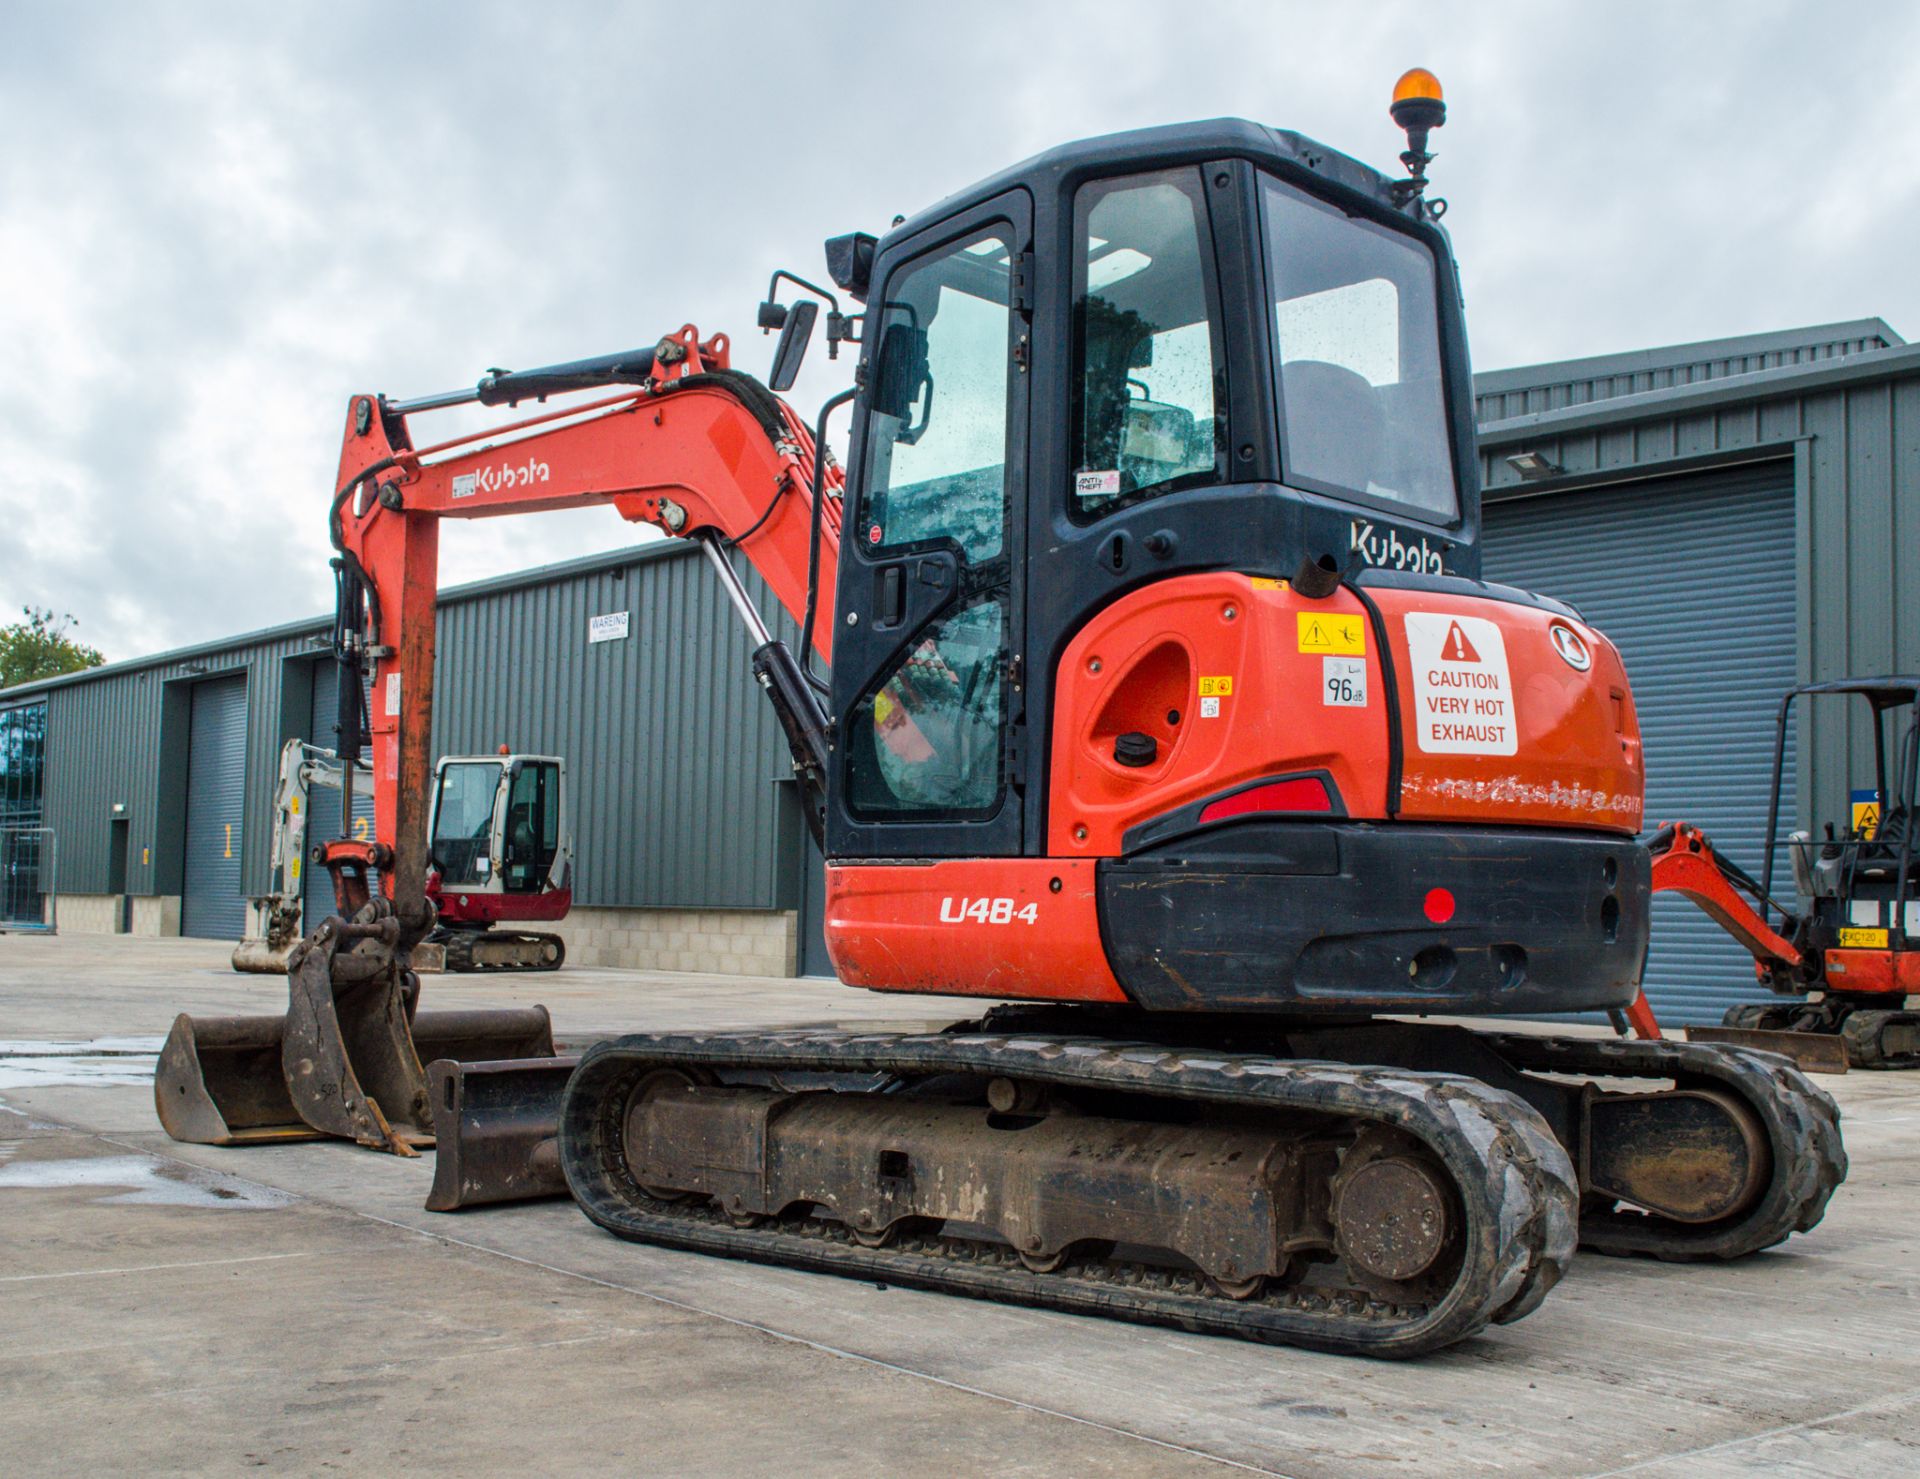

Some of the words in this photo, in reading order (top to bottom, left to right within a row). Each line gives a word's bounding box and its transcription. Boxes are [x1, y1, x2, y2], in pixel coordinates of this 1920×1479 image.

[476, 458, 549, 492] Kubota
[1351, 521, 1443, 576] Kubota
[592, 613, 627, 629] WAREING
[1328, 678, 1352, 702] 96
[1428, 670, 1499, 690] CAUTION
[1426, 696, 1469, 714] VERY
[1474, 699, 1505, 716] HOT
[1432, 724, 1506, 742] EXHAUST
[224, 823, 232, 858] 1
[354, 817, 369, 841] 2
